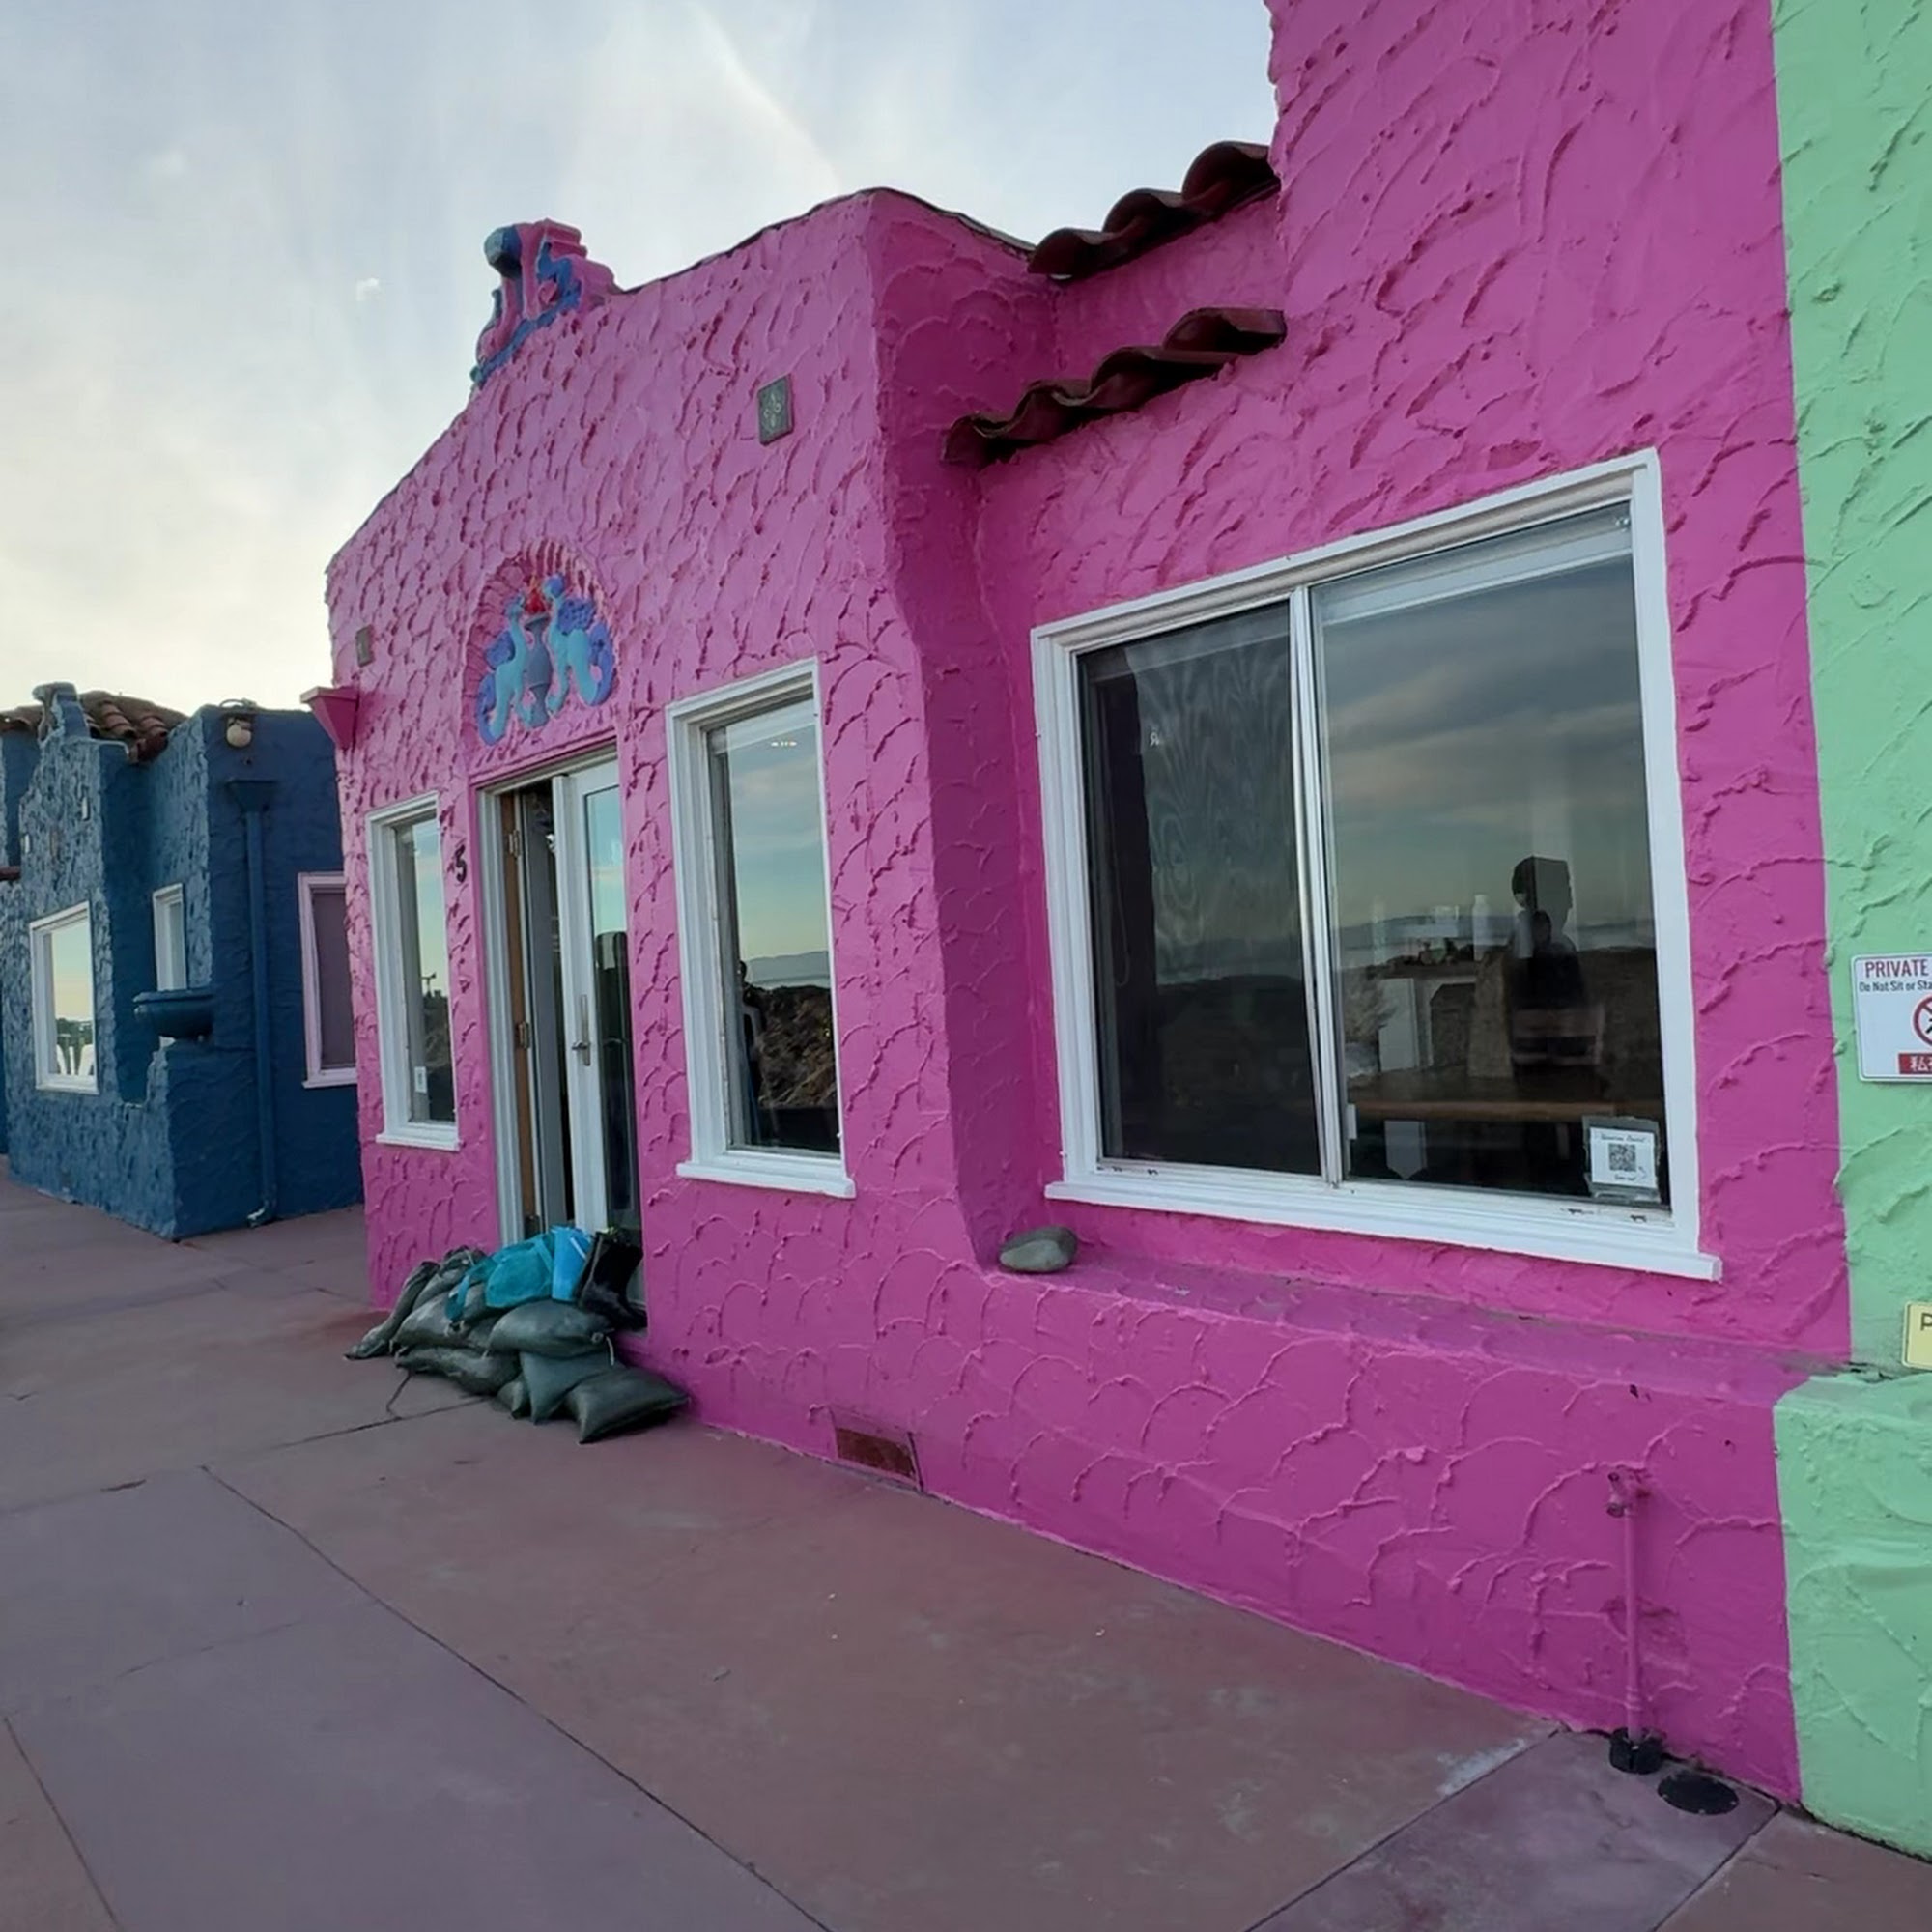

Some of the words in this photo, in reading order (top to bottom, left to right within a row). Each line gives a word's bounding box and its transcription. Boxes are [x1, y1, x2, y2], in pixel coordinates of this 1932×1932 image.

[455, 844, 467, 883] 5
[1865, 959, 1929, 978] PRIVATE
[1859, 981, 1870, 992] Do
[1872, 981, 1889, 992] Not
[1890, 980, 1904, 992] Sit
[1905, 982, 1915, 991] or
